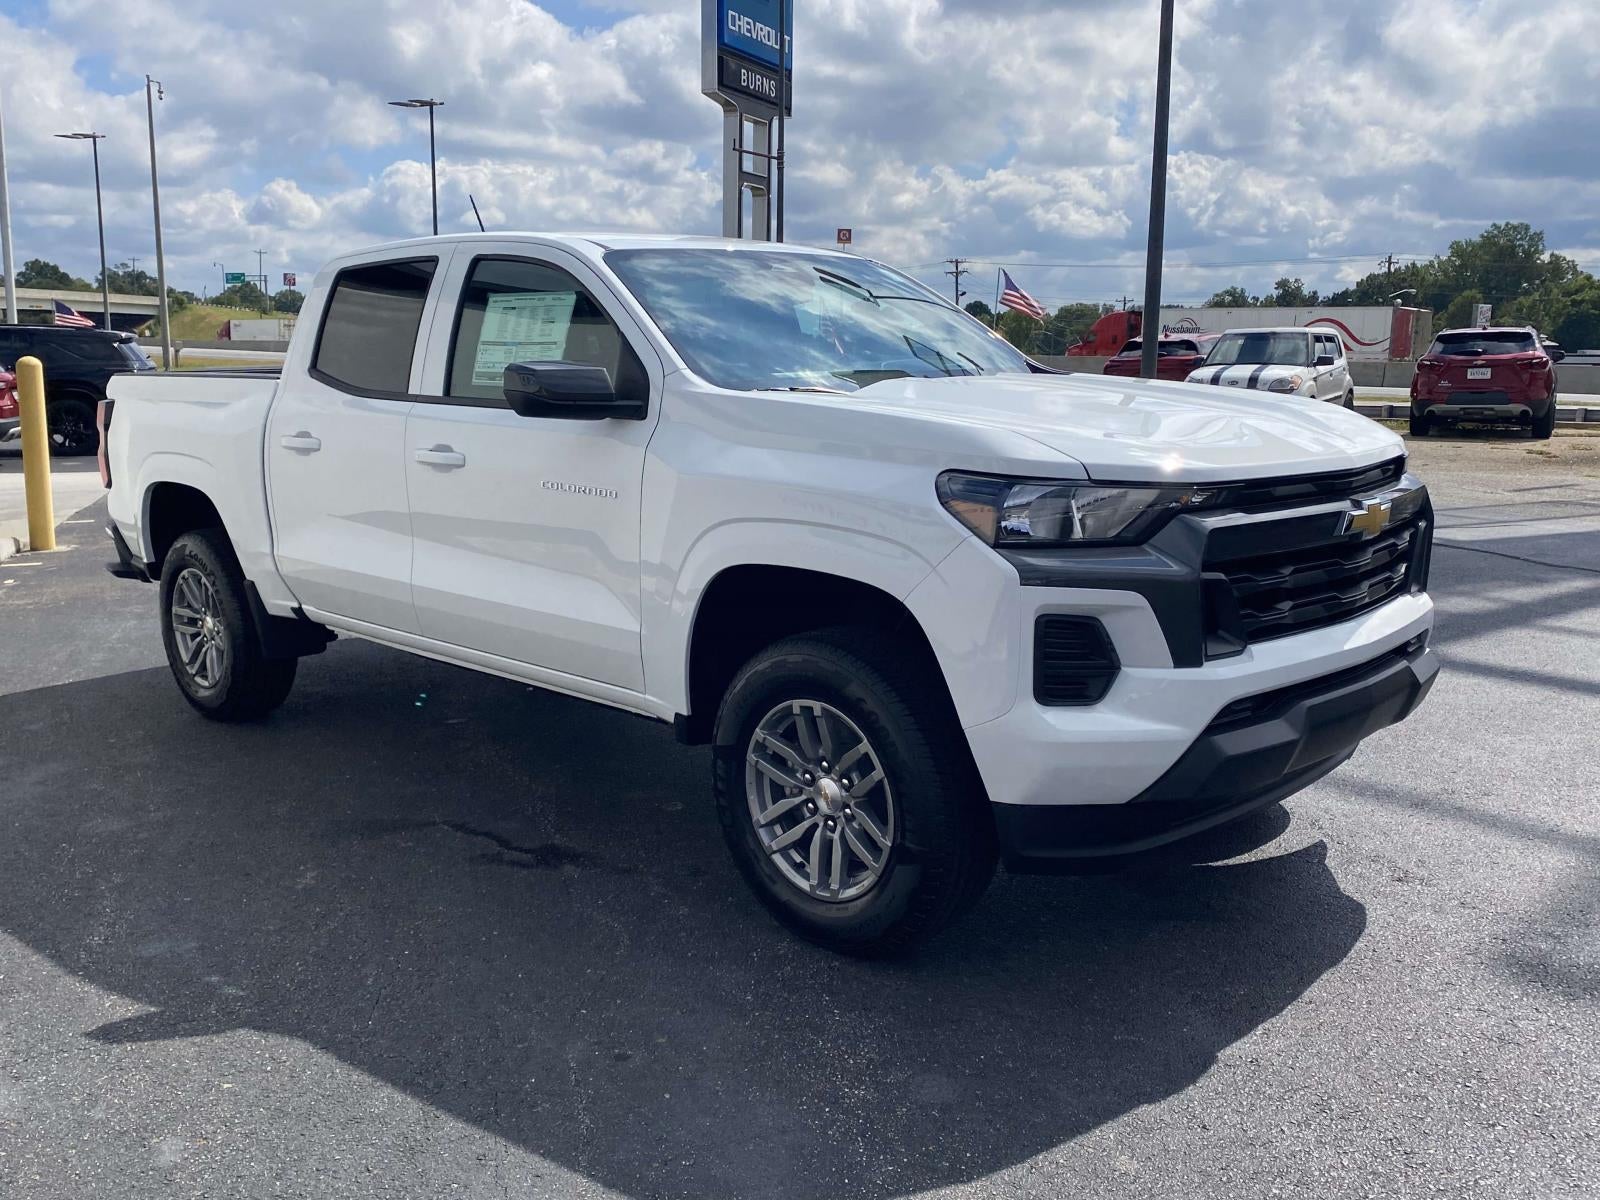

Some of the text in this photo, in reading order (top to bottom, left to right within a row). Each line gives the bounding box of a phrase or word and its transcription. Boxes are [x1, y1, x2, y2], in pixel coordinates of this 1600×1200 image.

[741, 68, 776, 97] BURNS
[1162, 324, 1200, 334] Nussbaum
[540, 480, 618, 498] COLORADO
